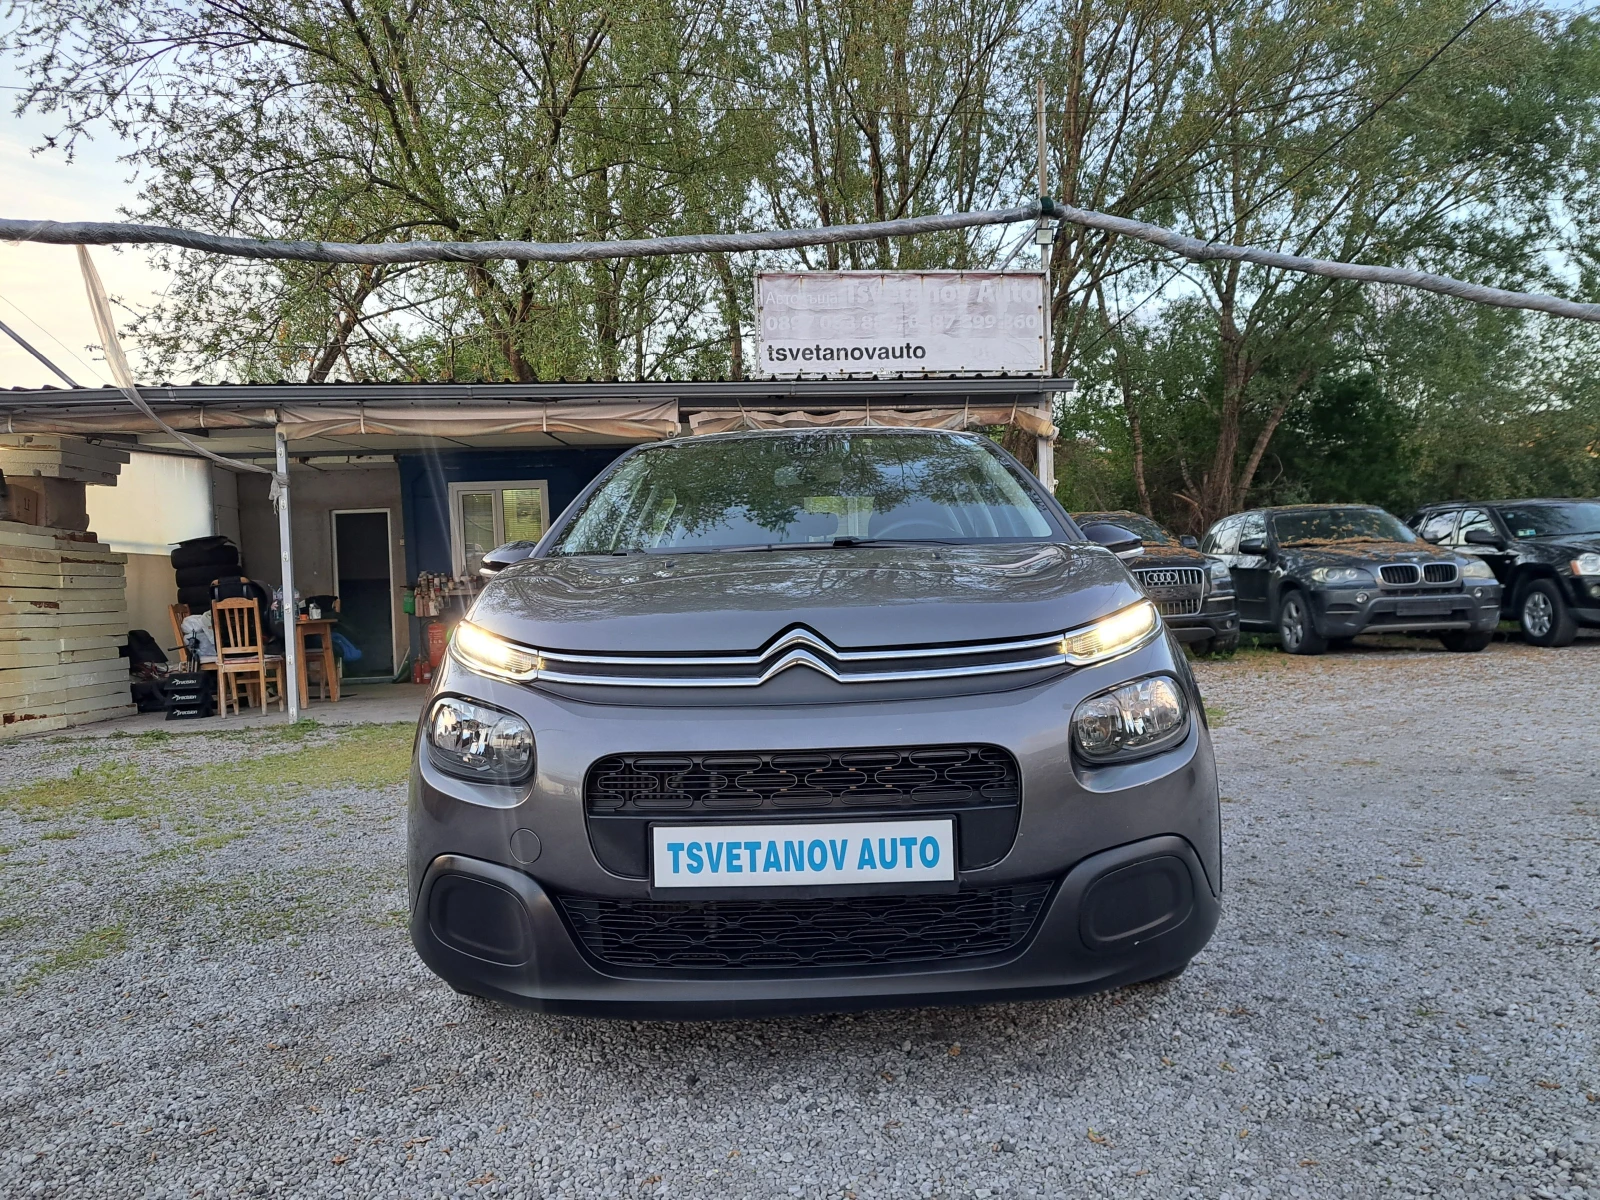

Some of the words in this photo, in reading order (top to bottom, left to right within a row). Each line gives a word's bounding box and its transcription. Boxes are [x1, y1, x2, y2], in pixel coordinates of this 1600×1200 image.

[765, 291, 838, 306] Автоъща
[767, 342, 927, 361] tsvetanovauto
[666, 839, 848, 874] TSVETANOV
[857, 835, 941, 870] AUTO
